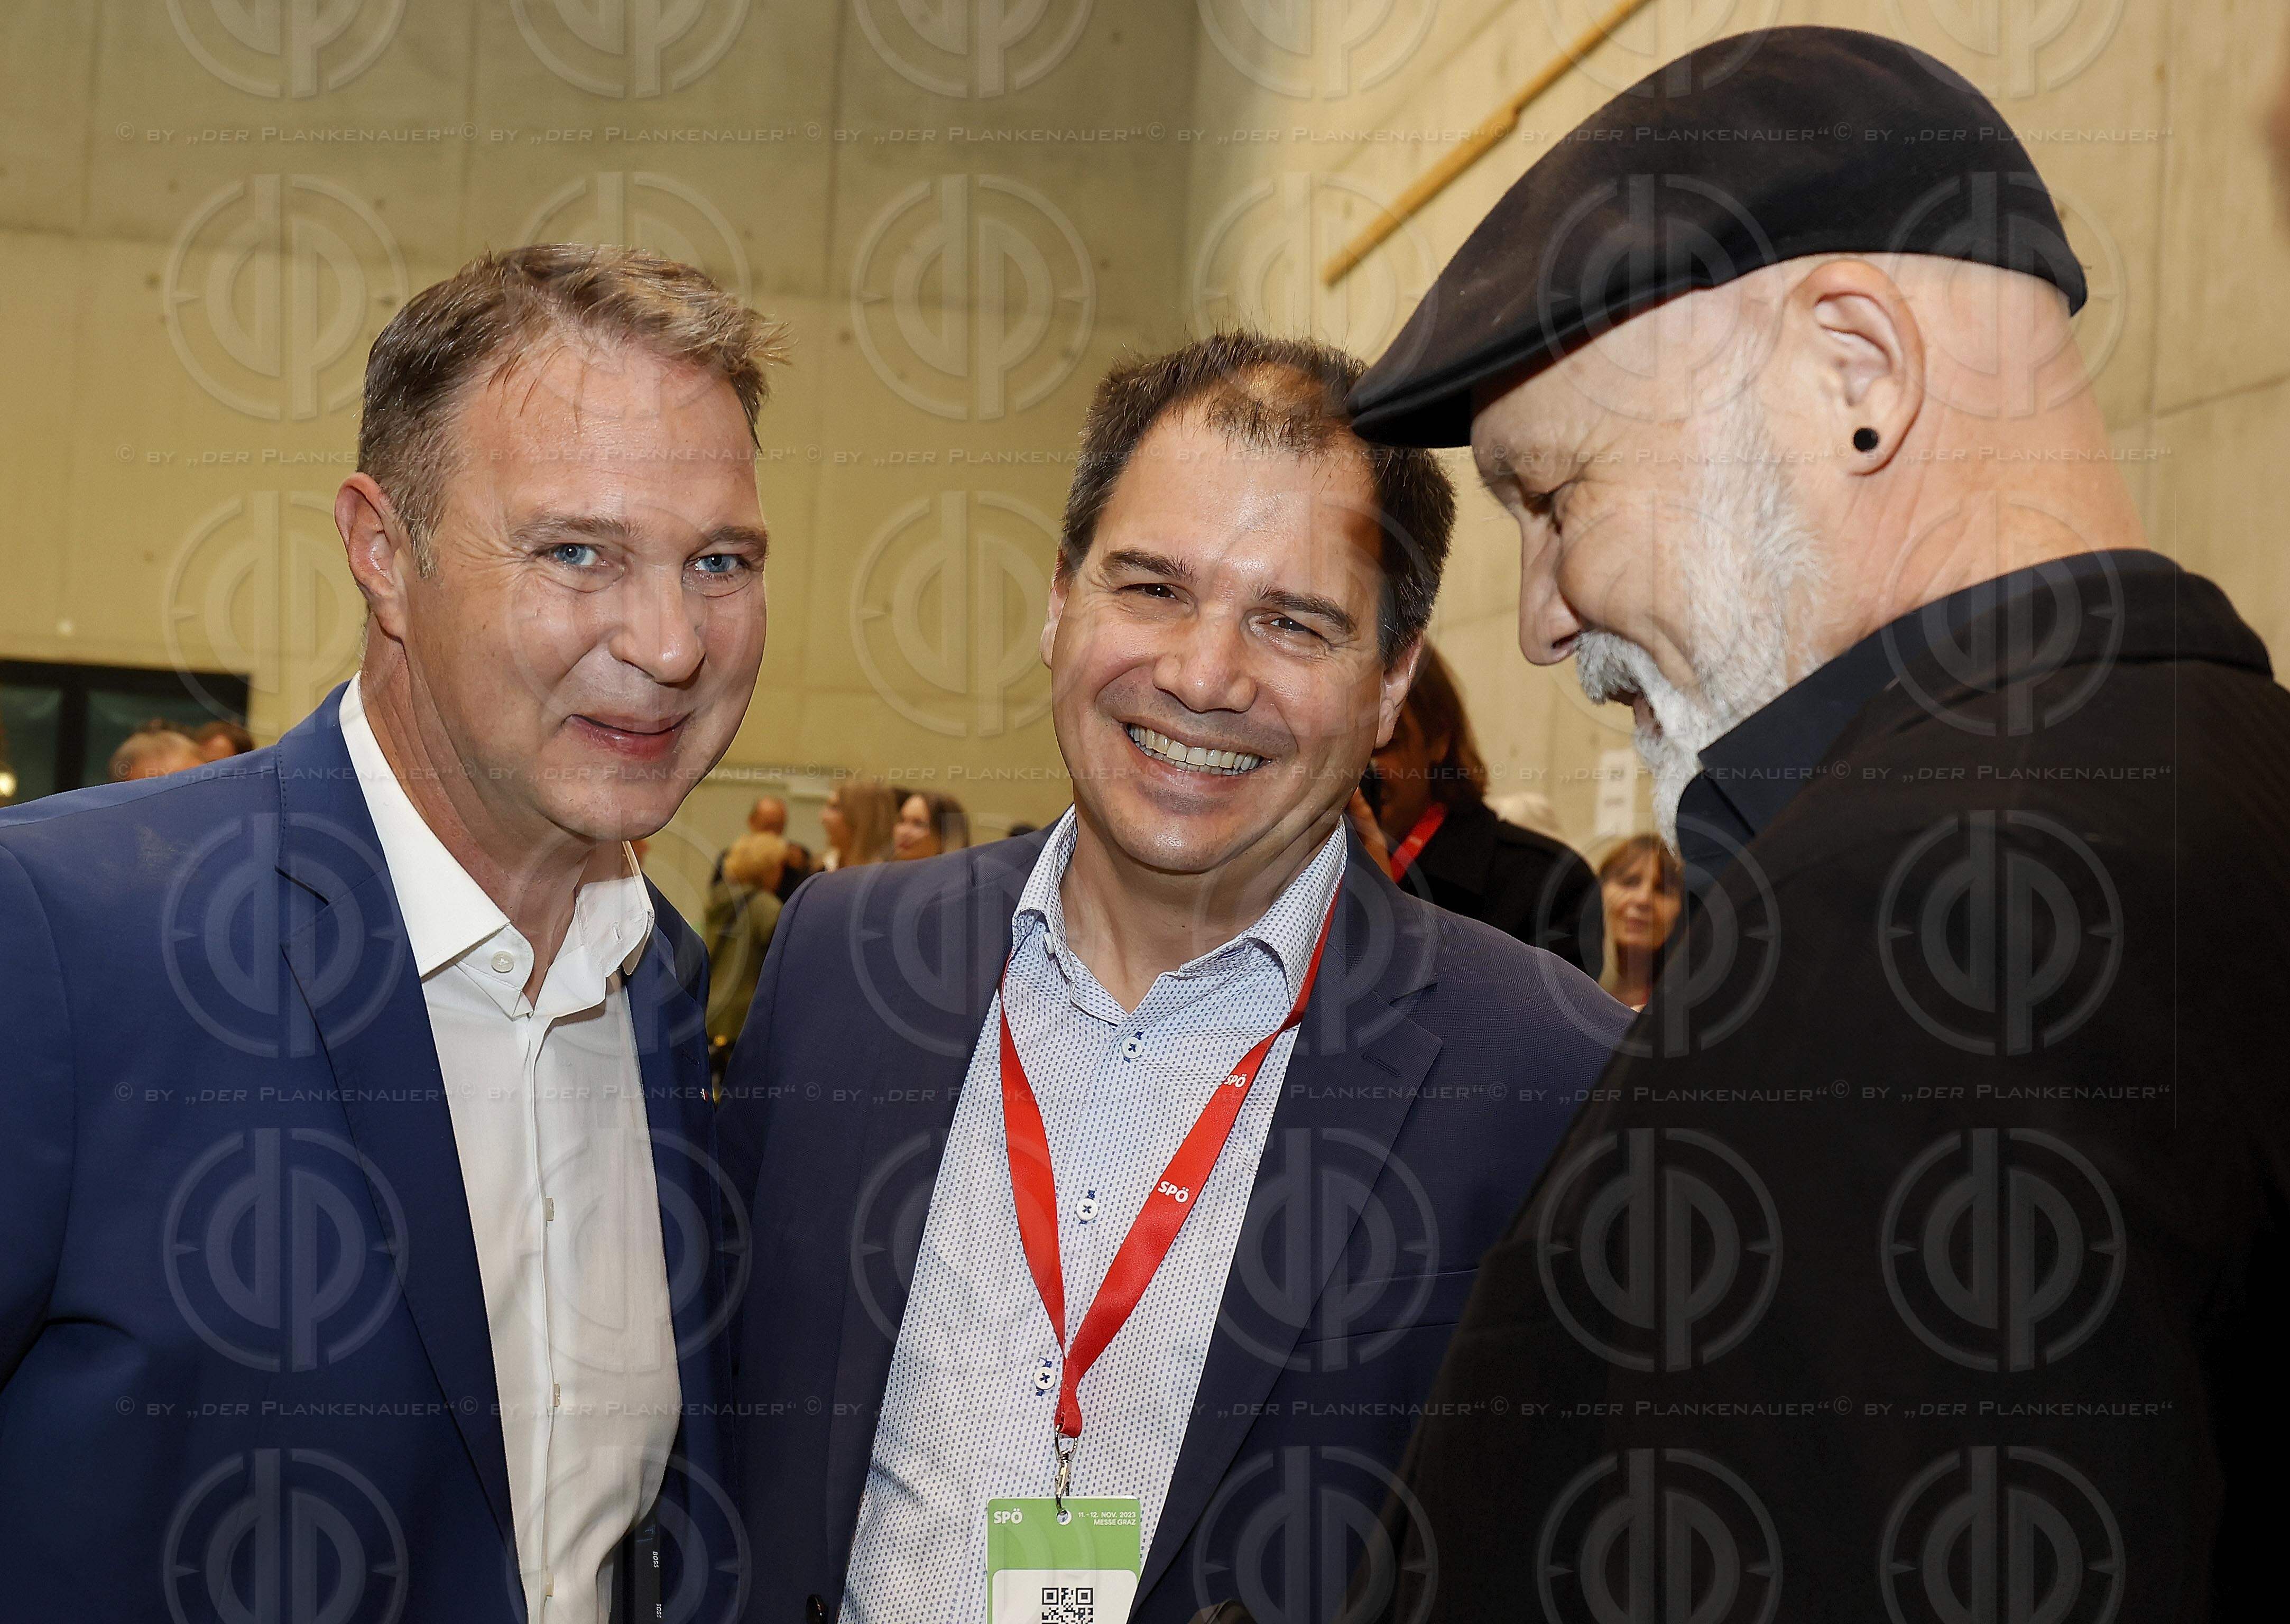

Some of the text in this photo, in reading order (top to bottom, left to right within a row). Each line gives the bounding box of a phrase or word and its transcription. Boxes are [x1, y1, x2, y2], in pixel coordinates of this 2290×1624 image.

[1224, 1074, 1246, 1087] SPÖ
[1158, 1181, 1189, 1203] SPÖ
[993, 1508, 1023, 1524] SPÖ
